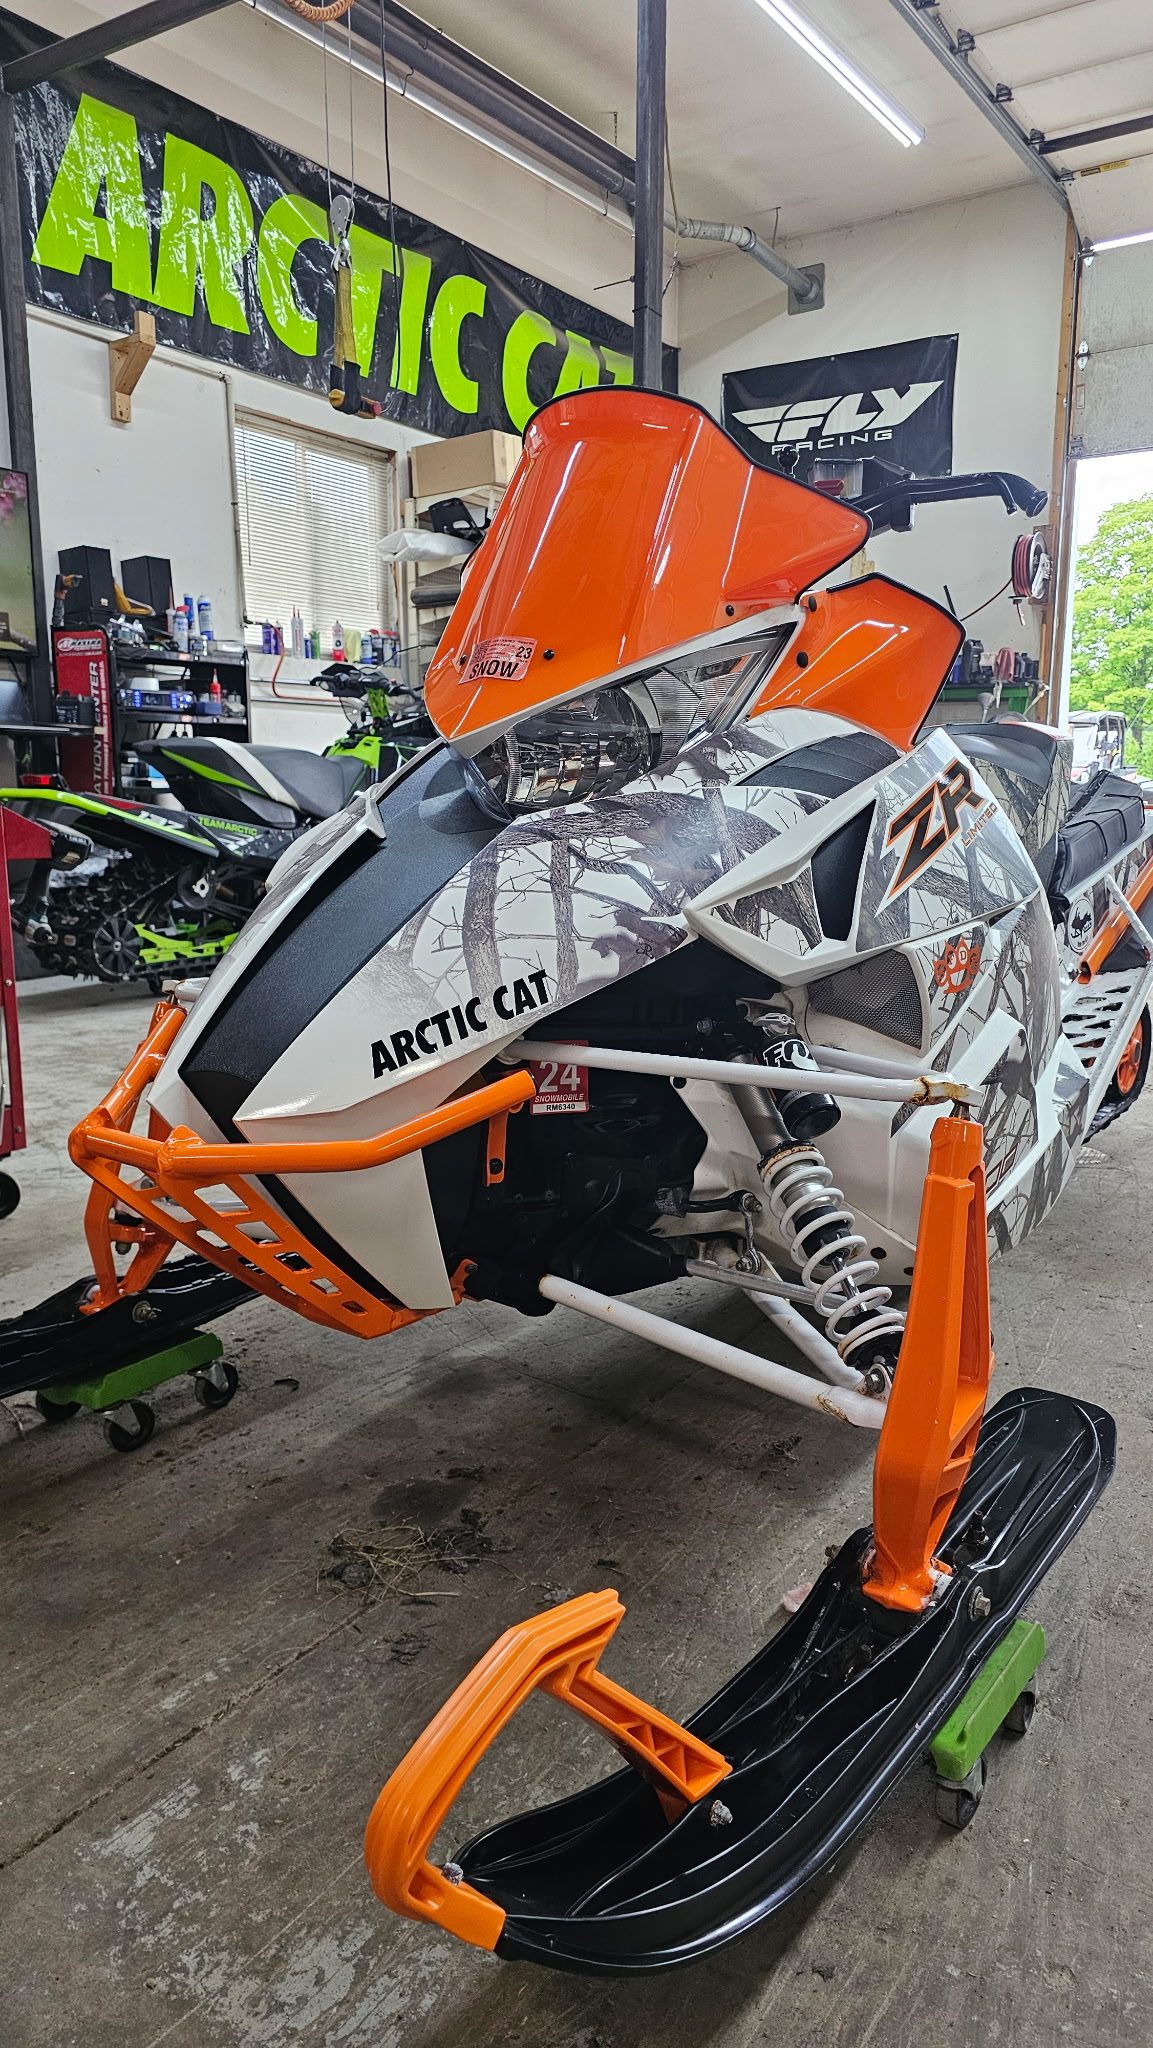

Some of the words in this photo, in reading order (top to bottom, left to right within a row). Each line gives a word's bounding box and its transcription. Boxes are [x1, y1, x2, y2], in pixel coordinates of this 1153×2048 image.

[31, 93, 486, 415] ARCTIC
[732, 380, 945, 443] FLY
[469, 659, 519, 679] SNOW
[516, 646, 533, 659] 23
[88, 661, 101, 728] ENTER
[886, 758, 985, 900] ZR
[961, 802, 998, 847] LIMITED
[371, 997, 488, 1080] ARCTIC
[493, 969, 551, 1021] CAT
[535, 1093, 584, 1103] SNOWMOBILE
[539, 1061, 580, 1093] 24
[546, 1103, 576, 1112] RM6340
